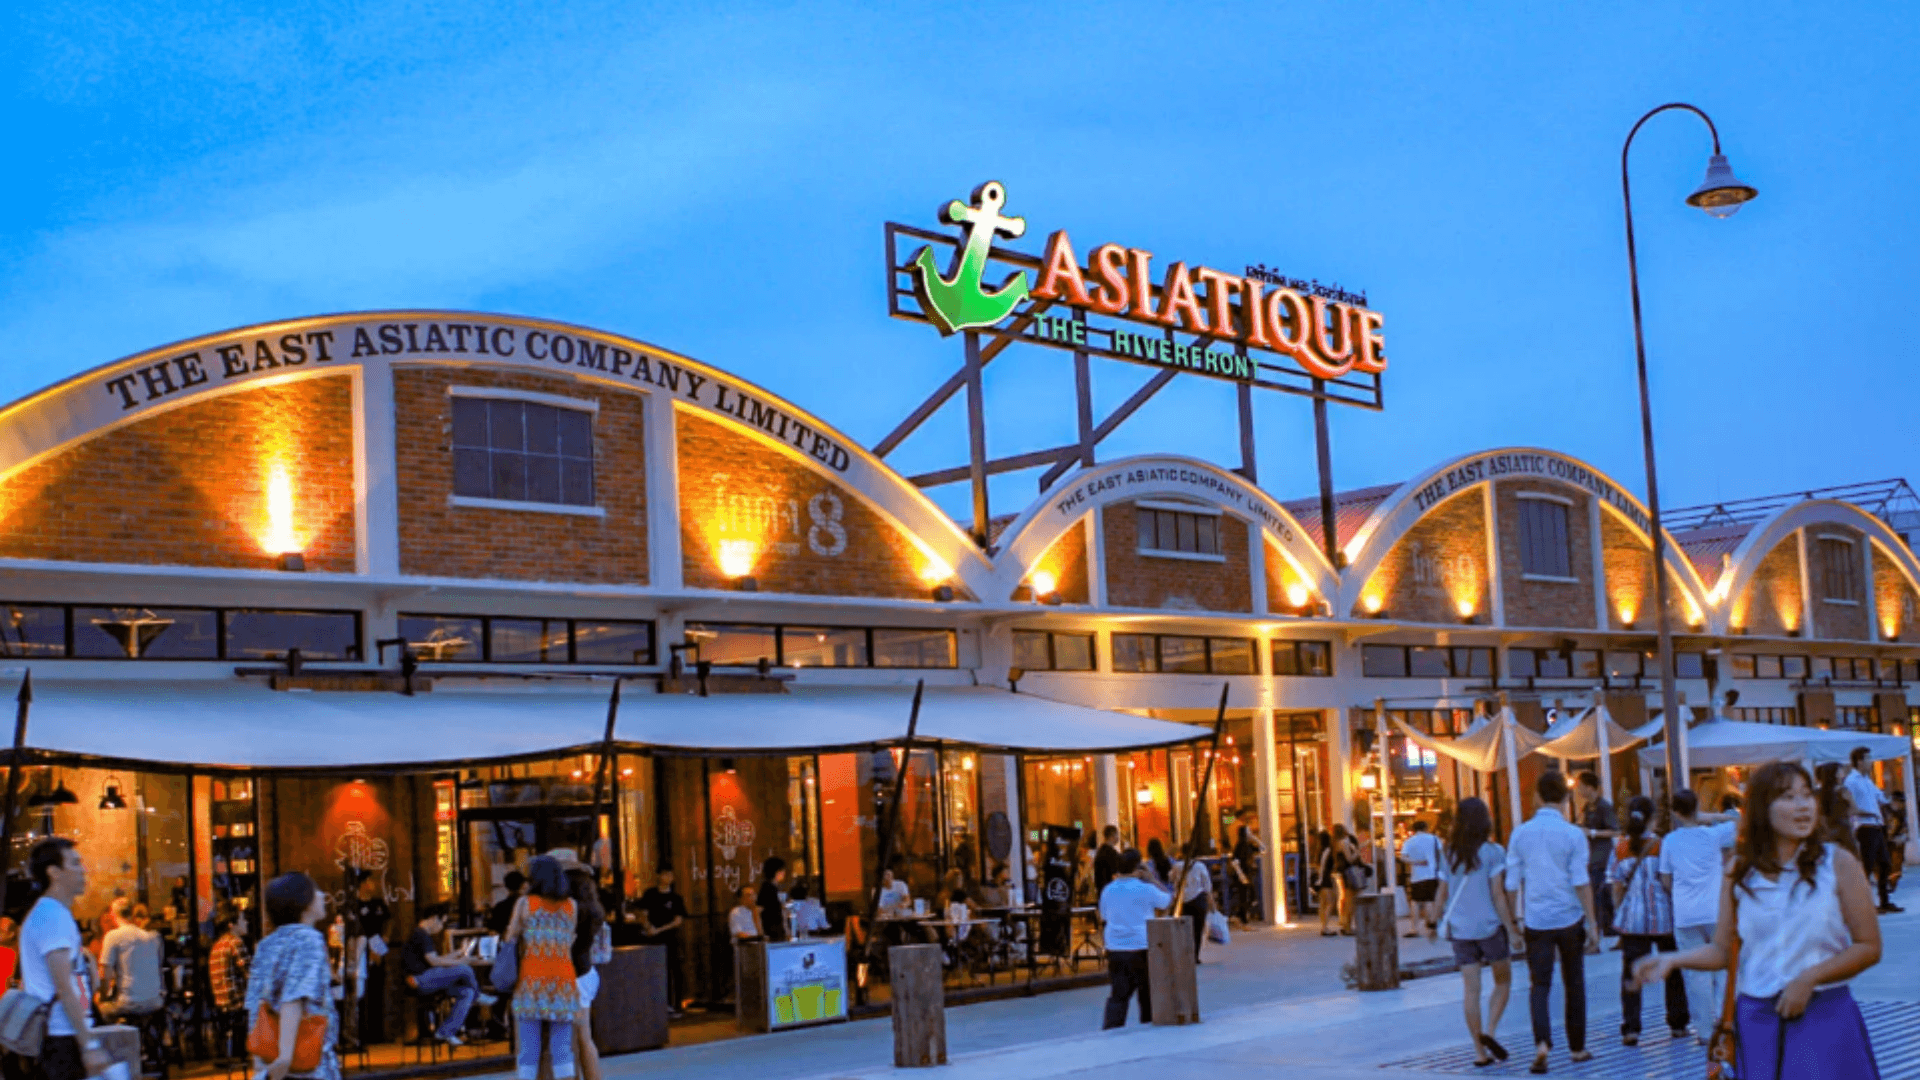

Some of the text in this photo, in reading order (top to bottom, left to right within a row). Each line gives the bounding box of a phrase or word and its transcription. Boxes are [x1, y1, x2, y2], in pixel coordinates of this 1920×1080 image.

[1030, 229, 1387, 379] ASIATIQUE
[1033, 312, 1260, 379] THE RIVERFRONT
[105, 323, 851, 473] THE EAST ASIATIC COMPANY LIMITED
[1057, 468, 1293, 543] THE EAST ASIATIC COMPANY LIMITED
[1413, 479, 1446, 512] THE
[1446, 460, 1484, 491] EAST
[1489, 454, 1544, 476] ASIATIC
[1548, 458, 1613, 502] COMPANY
[808, 491, 848, 557] 8
